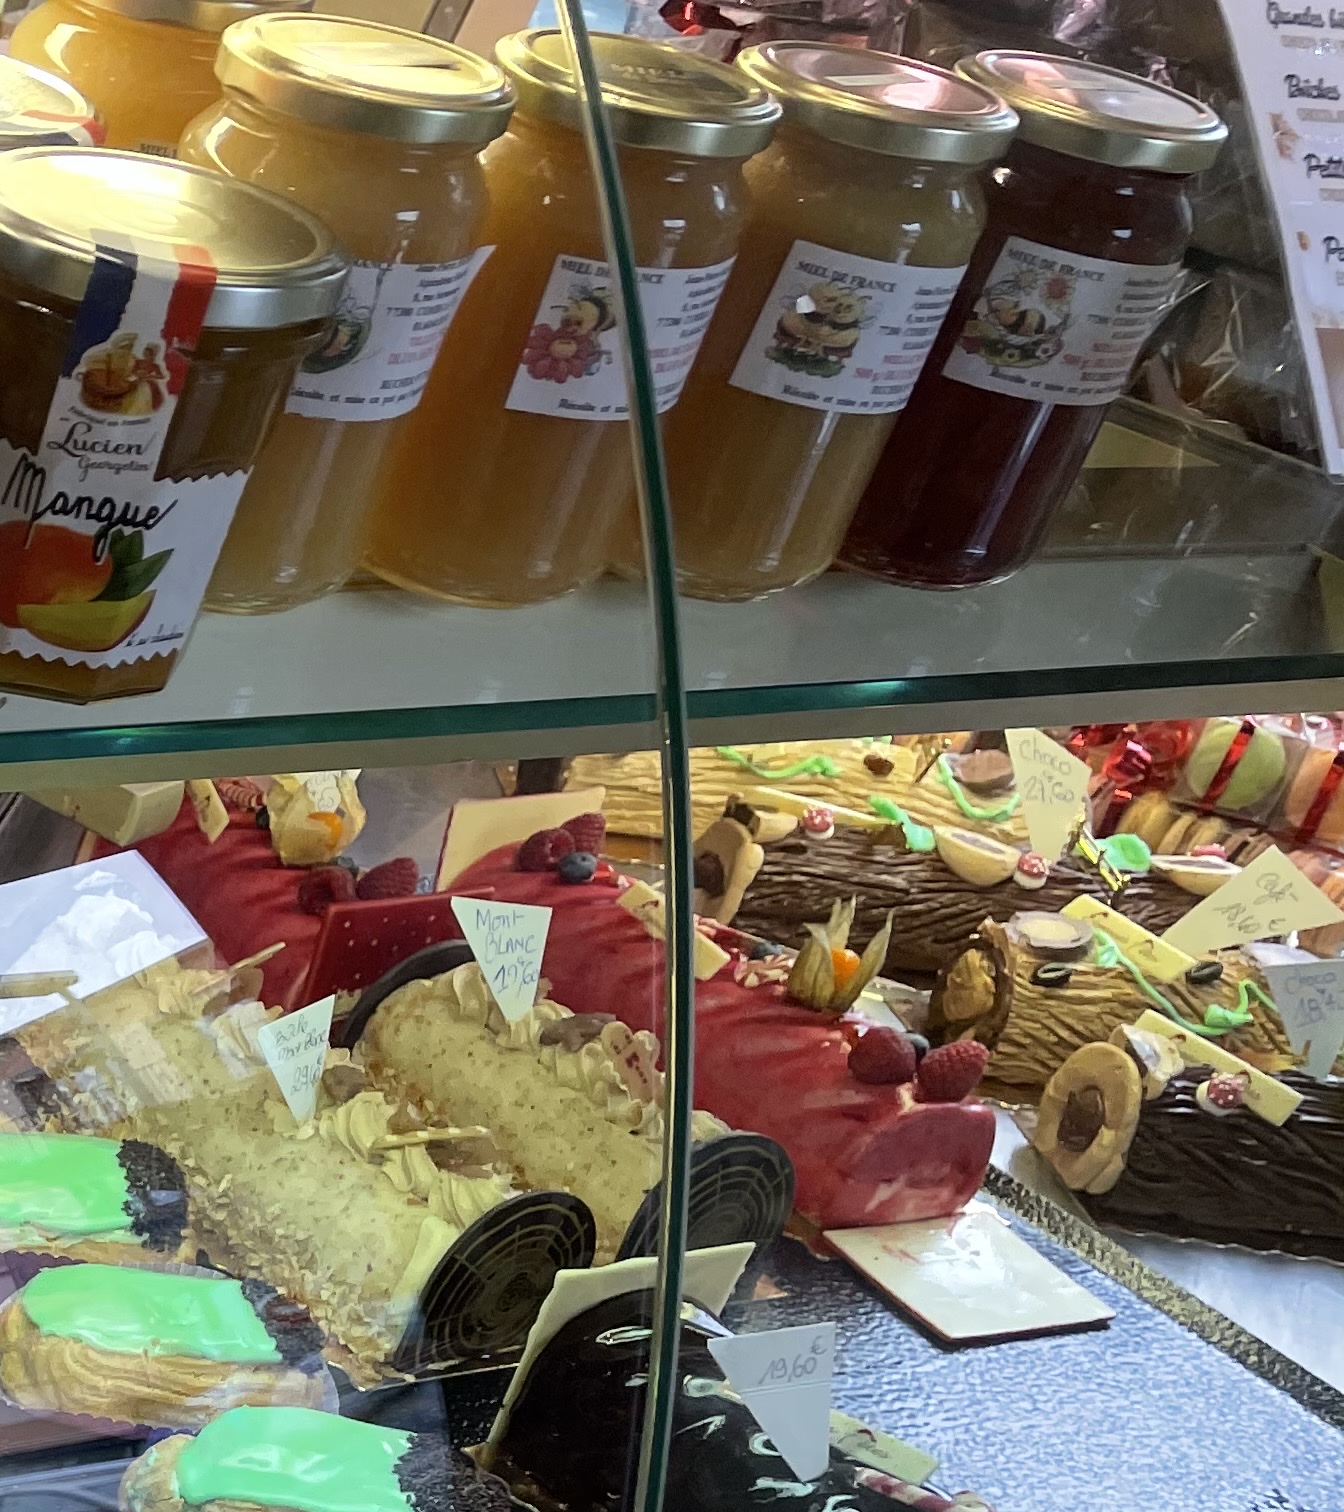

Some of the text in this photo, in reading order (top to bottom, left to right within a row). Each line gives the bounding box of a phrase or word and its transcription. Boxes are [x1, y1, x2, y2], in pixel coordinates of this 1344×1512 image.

[795, 260, 828, 278] MIEL
[849, 272, 897, 293] FRANCE
[47, 421, 157, 458] Lucien
[1, 452, 179, 564] Mangue
